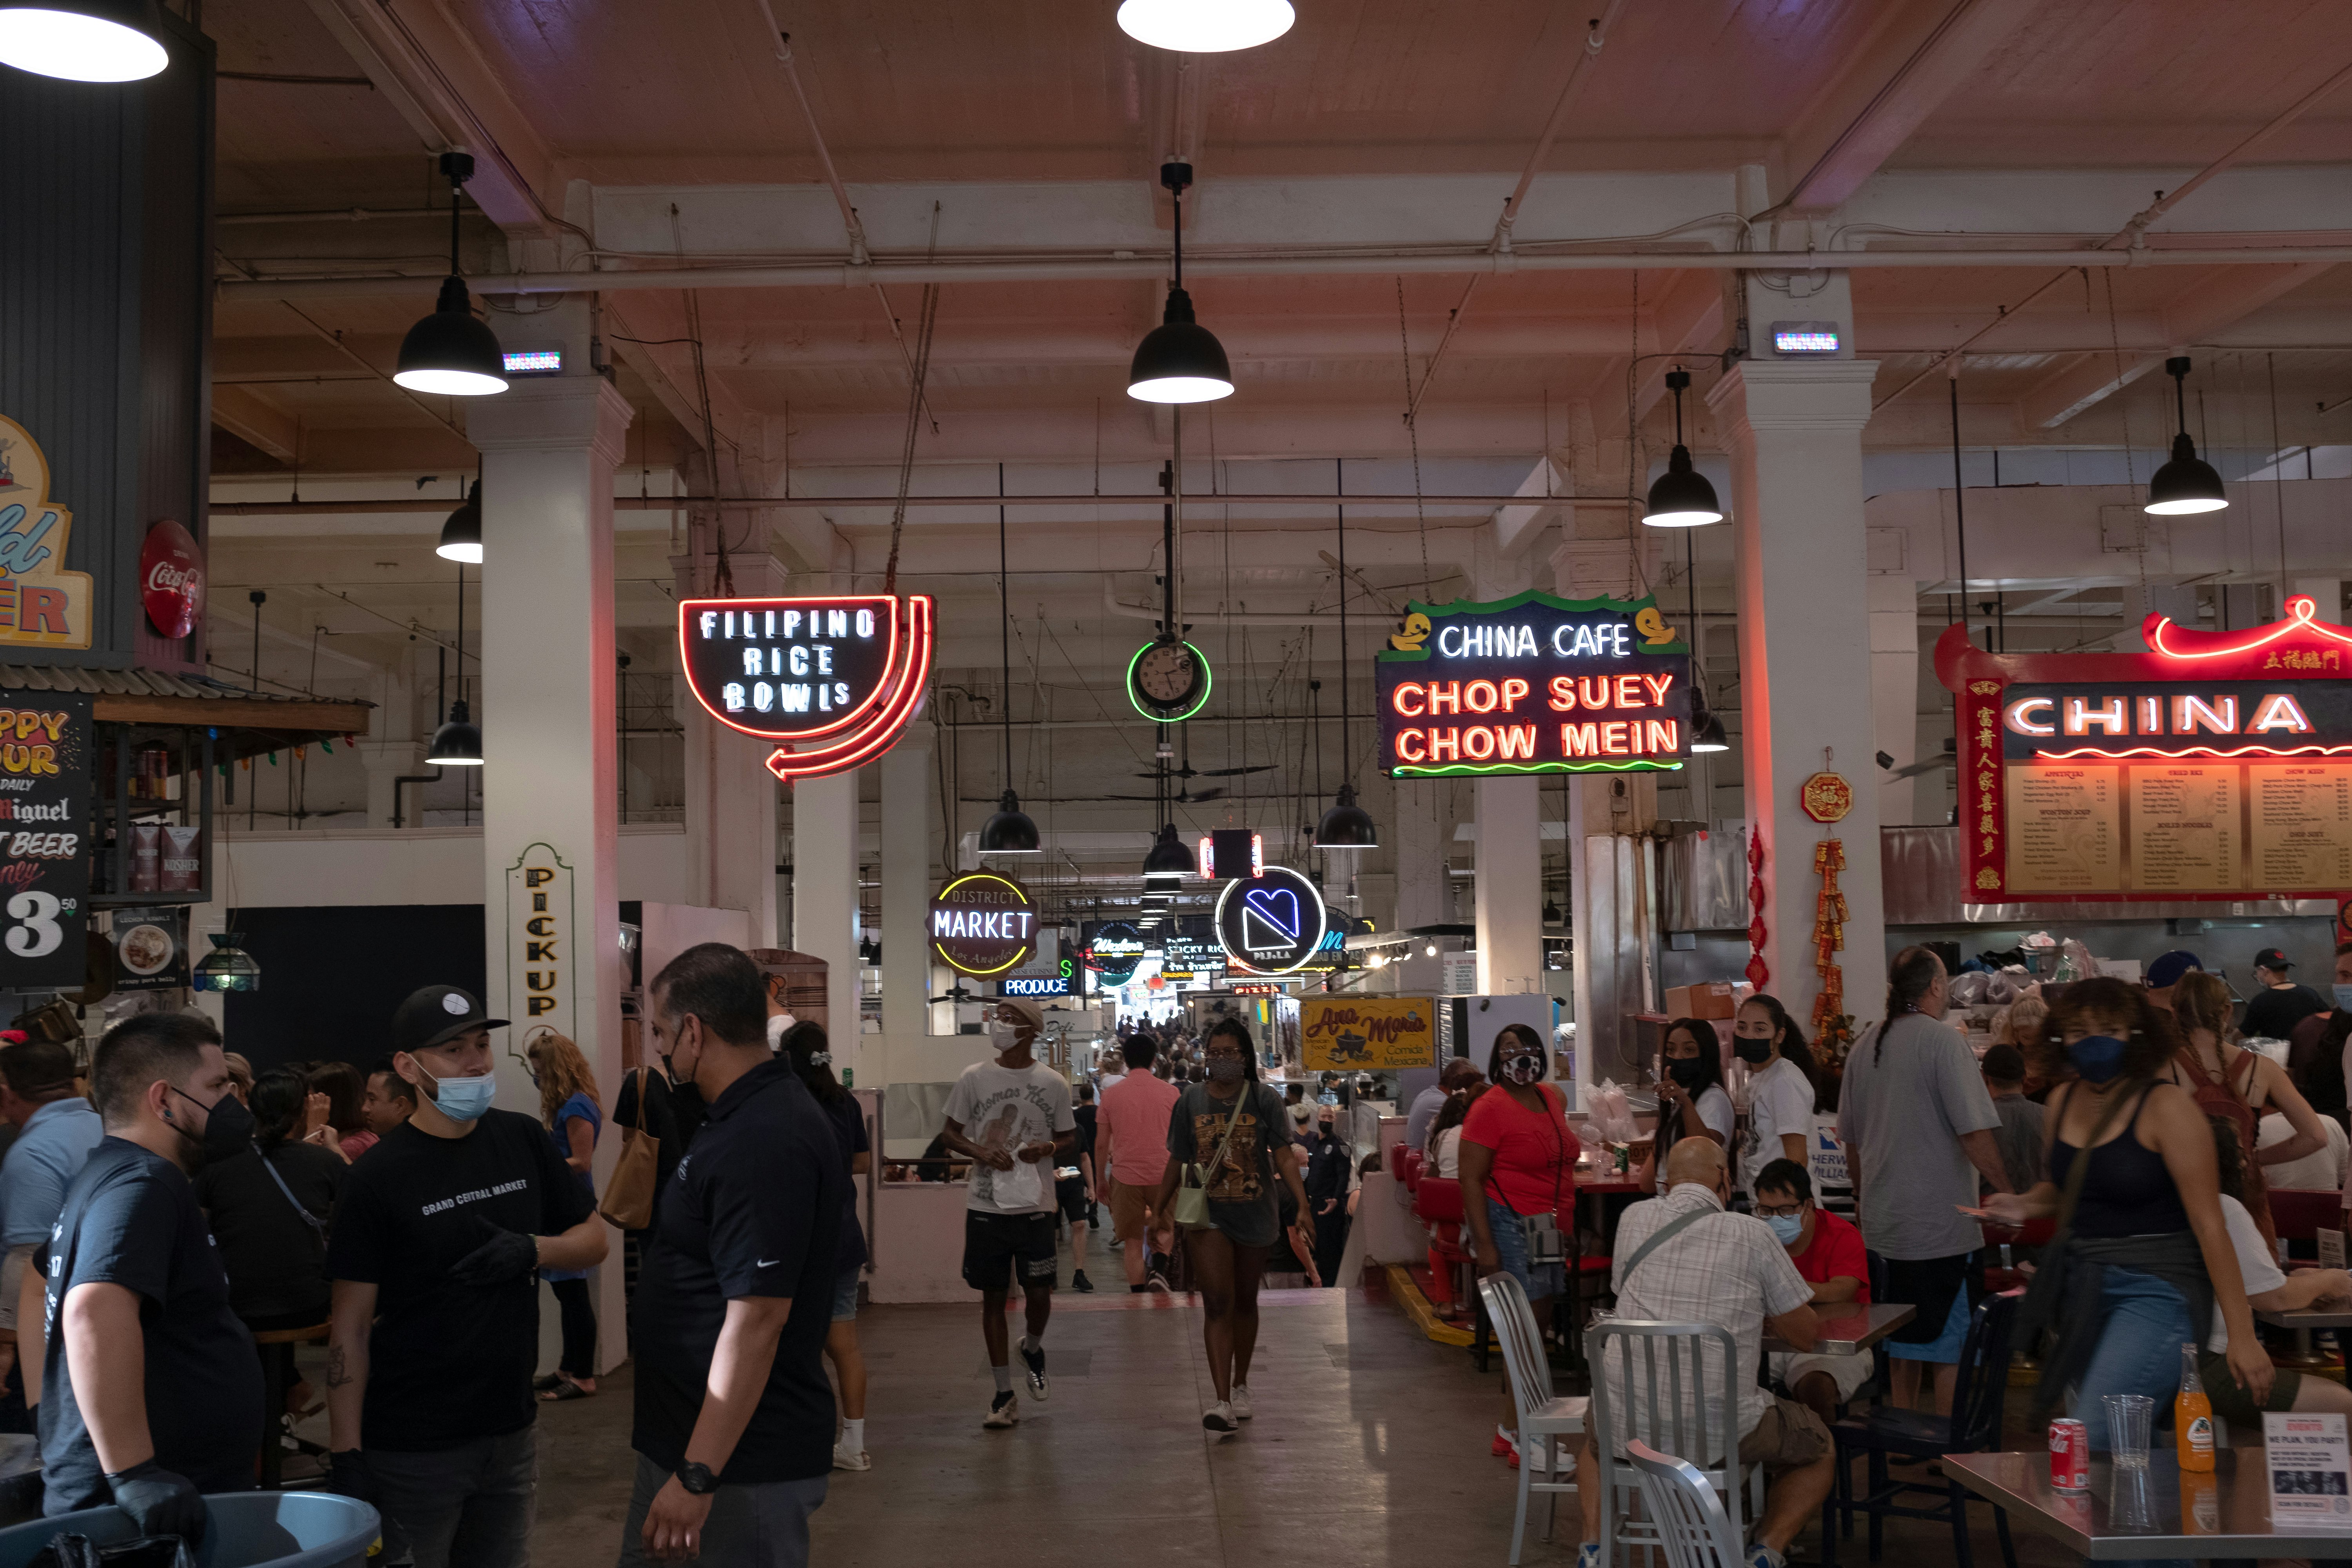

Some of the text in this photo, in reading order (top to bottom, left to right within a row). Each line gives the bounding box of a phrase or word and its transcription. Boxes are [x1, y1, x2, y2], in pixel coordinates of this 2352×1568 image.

[700, 609, 875, 639] FILIPINO
[1438, 623, 1631, 659] CHINA CAFE
[744, 643, 833, 675] RICE
[723, 681, 850, 712] BOWLS
[1392, 671, 1673, 718] CHOP SUEY
[2004, 693, 2317, 737] CHINA
[1394, 717, 1679, 763] CHOW MEIN
[0, 744, 60, 775] UR
[9, 831, 78, 857] BEER
[952, 890, 1016, 904] DISTRICT
[5, 891, 77, 957] 3 50
[934, 911, 1033, 939] MARKET
[951, 946, 1013, 967] Los Angeles
[1207, 945, 1225, 953] RIC
[1005, 978, 1069, 995] PRODUCE
[1235, 985, 1280, 995] PIZZA
[1046, 1020, 1075, 1033] Deli
[1306, 1007, 1427, 1044] Ana Maria
[1383, 1056, 1428, 1066] Mexicana
[1386, 1044, 1423, 1055] Comida
[1812, 1154, 1847, 1165] HERW
[421, 1198, 456, 1216] GRAND
[491, 1179, 527, 1196] MARKET
